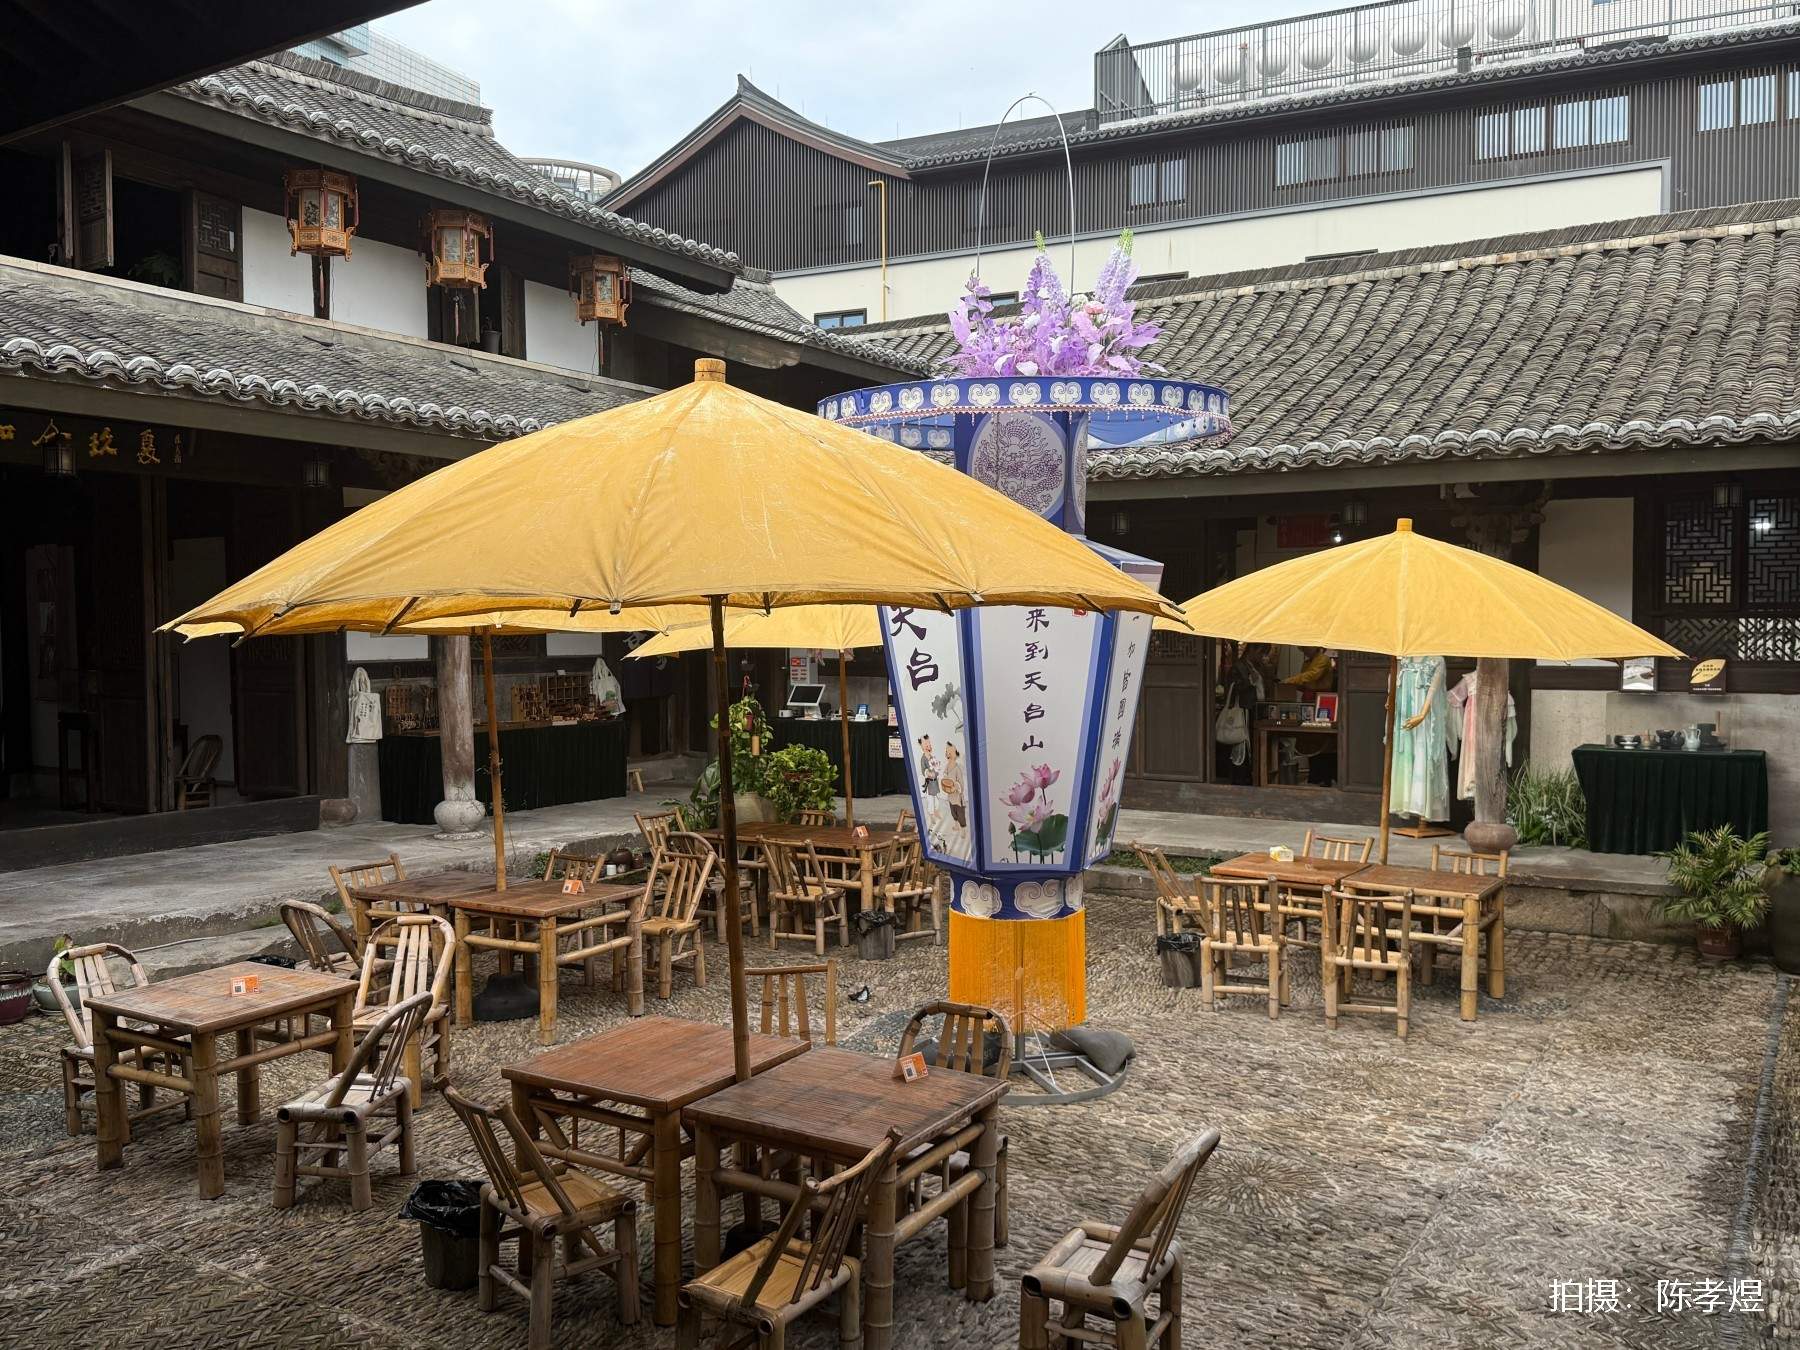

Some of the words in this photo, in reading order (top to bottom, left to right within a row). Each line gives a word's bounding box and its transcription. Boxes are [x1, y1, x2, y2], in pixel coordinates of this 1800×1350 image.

[1022, 609, 1050, 751] 来到天台山
